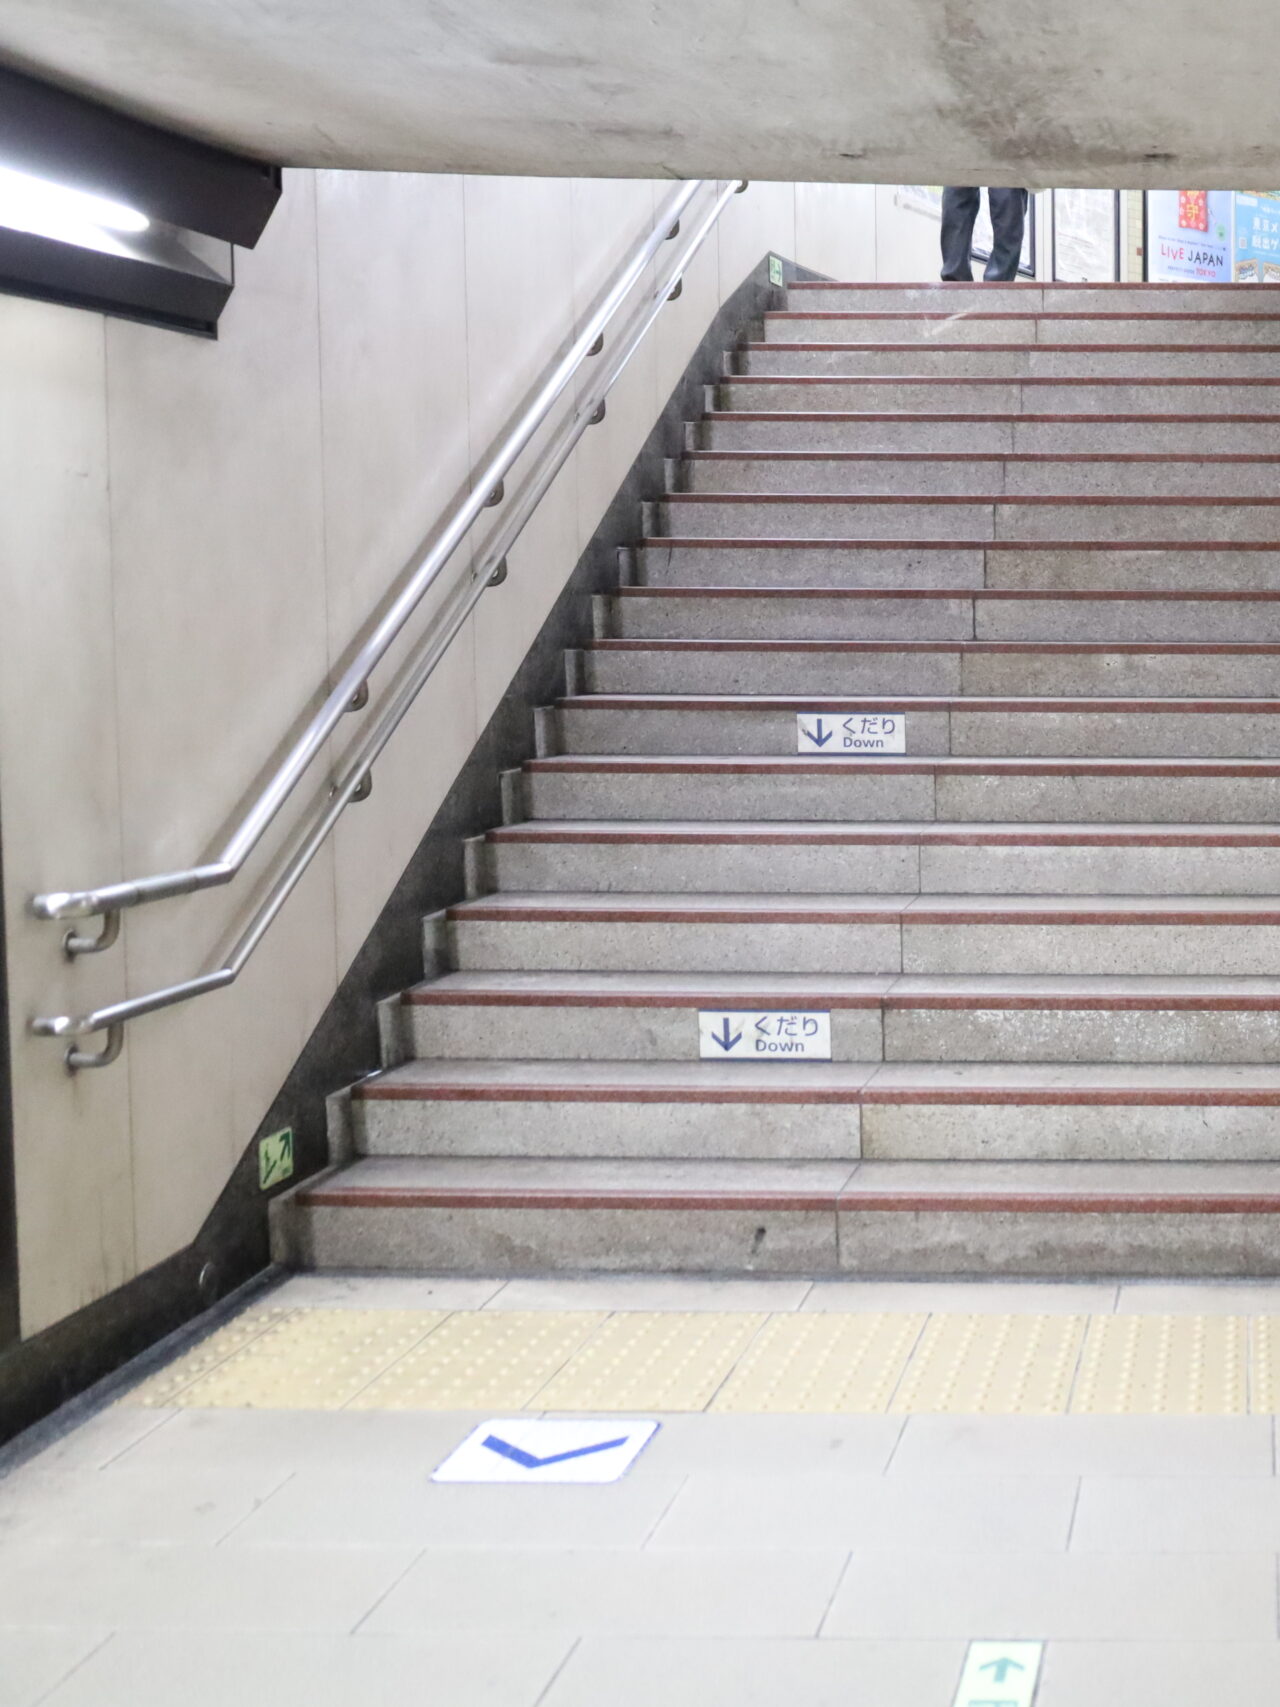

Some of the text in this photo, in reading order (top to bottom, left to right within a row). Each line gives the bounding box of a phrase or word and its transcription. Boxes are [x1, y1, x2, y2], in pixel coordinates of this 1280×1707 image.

[1161, 243, 1224, 267] LIVE JAPAN
[1196, 267, 1217, 278] TOKYO
[842, 717, 895, 735] くだり
[843, 737, 884, 748] Down
[754, 1015, 818, 1037] くだり
[755, 1039, 805, 1052] Down
